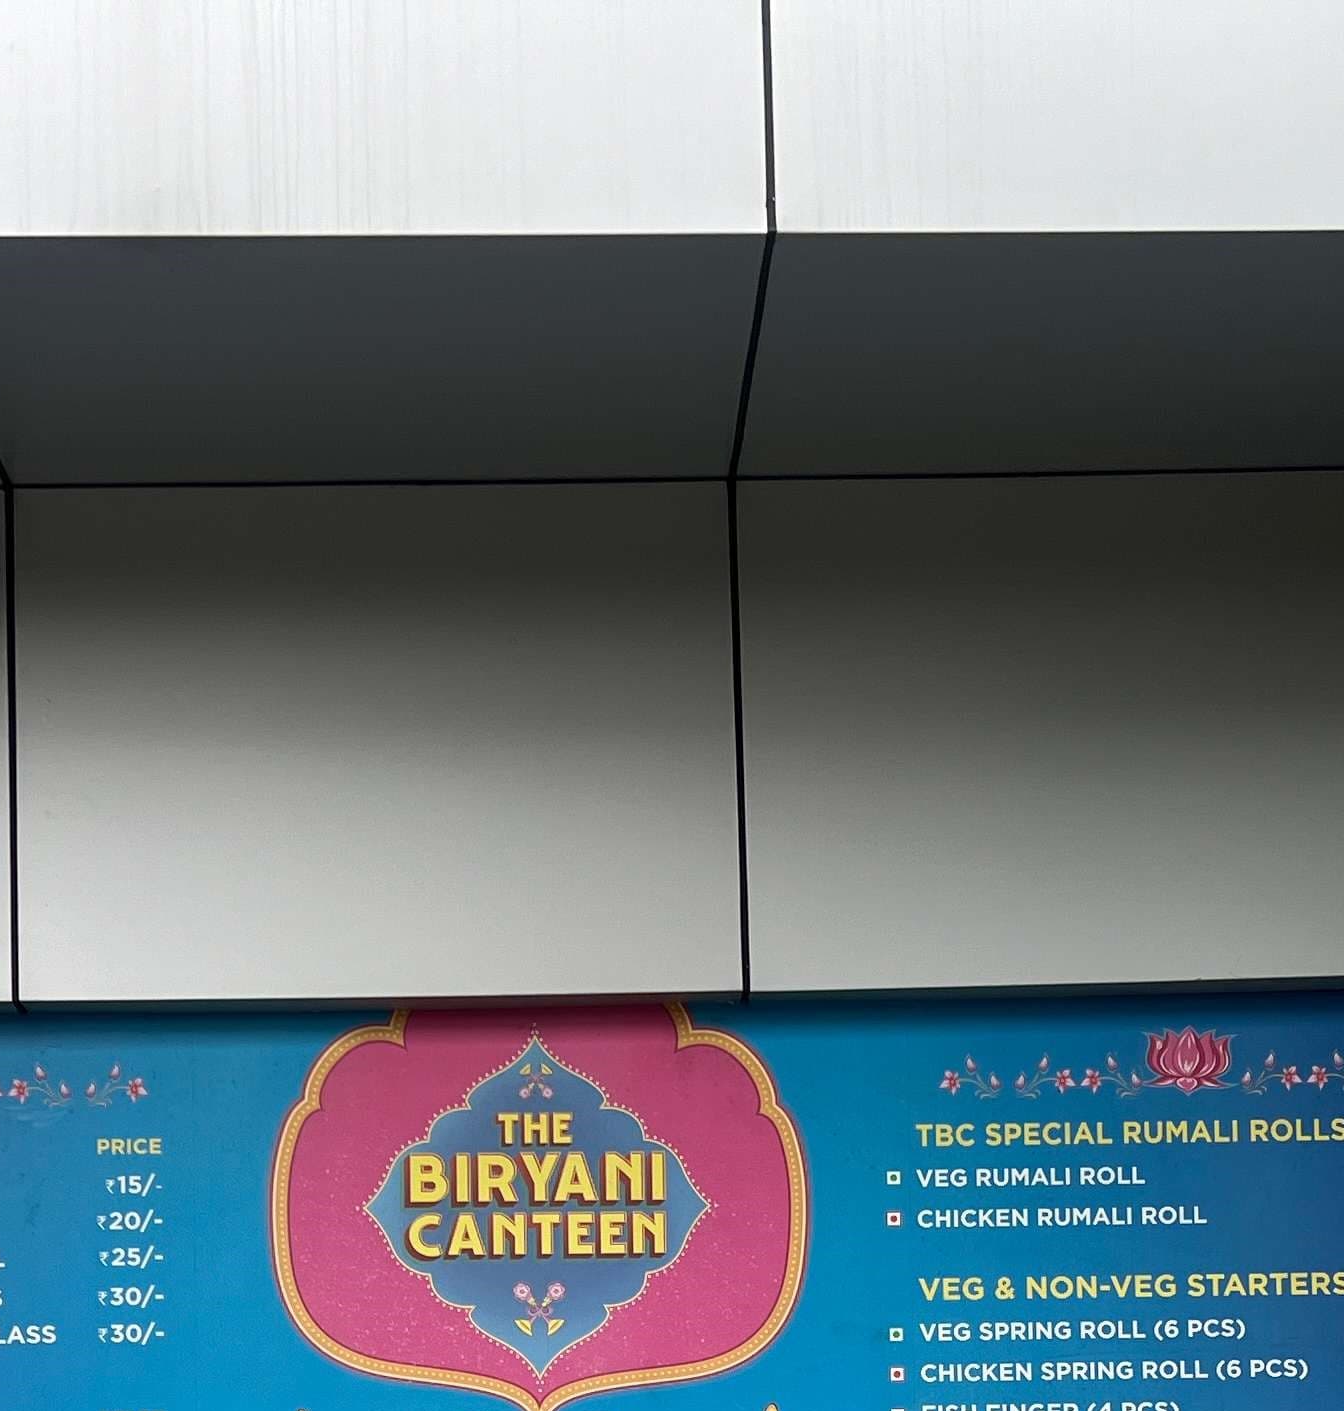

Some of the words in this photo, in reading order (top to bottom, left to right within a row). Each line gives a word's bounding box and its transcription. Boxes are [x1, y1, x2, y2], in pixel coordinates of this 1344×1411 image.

[498, 1112, 572, 1145] THE
[915, 1123, 976, 1147] TBC
[985, 1121, 1113, 1147] SPECIAL
[1123, 1119, 1239, 1144] RUMALI
[96, 1137, 162, 1155] PRICE
[407, 1152, 666, 1207] BIRYANI
[916, 1168, 968, 1188] VEG
[975, 1167, 1071, 1187] RUMALI
[1079, 1166, 1146, 1185] ROLL
[917, 1208, 1029, 1229] CHICKEN
[1037, 1206, 1133, 1227] RUMALI
[1141, 1205, 1208, 1225] ROLL
[407, 1213, 666, 1259] CANTEEN
[918, 1276, 985, 1302] VEG
[994, 1276, 1015, 1300] &
[1026, 1273, 1177, 1300] NON-VEG
[919, 1322, 972, 1342] VEG
[979, 1321, 1072, 1341] SPRING
[1080, 1319, 1147, 1339] ROLL
[1153, 1319, 1180, 1342] (6
[1187, 1318, 1246, 1340] PCS)
[920, 1362, 1033, 1383] CHICKEN
[1040, 1360, 1134, 1381] SPRING
[1142, 1359, 1209, 1379] ROLL
[1216, 1359, 1242, 1381] (6
[1249, 1358, 1309, 1380] PCS)
